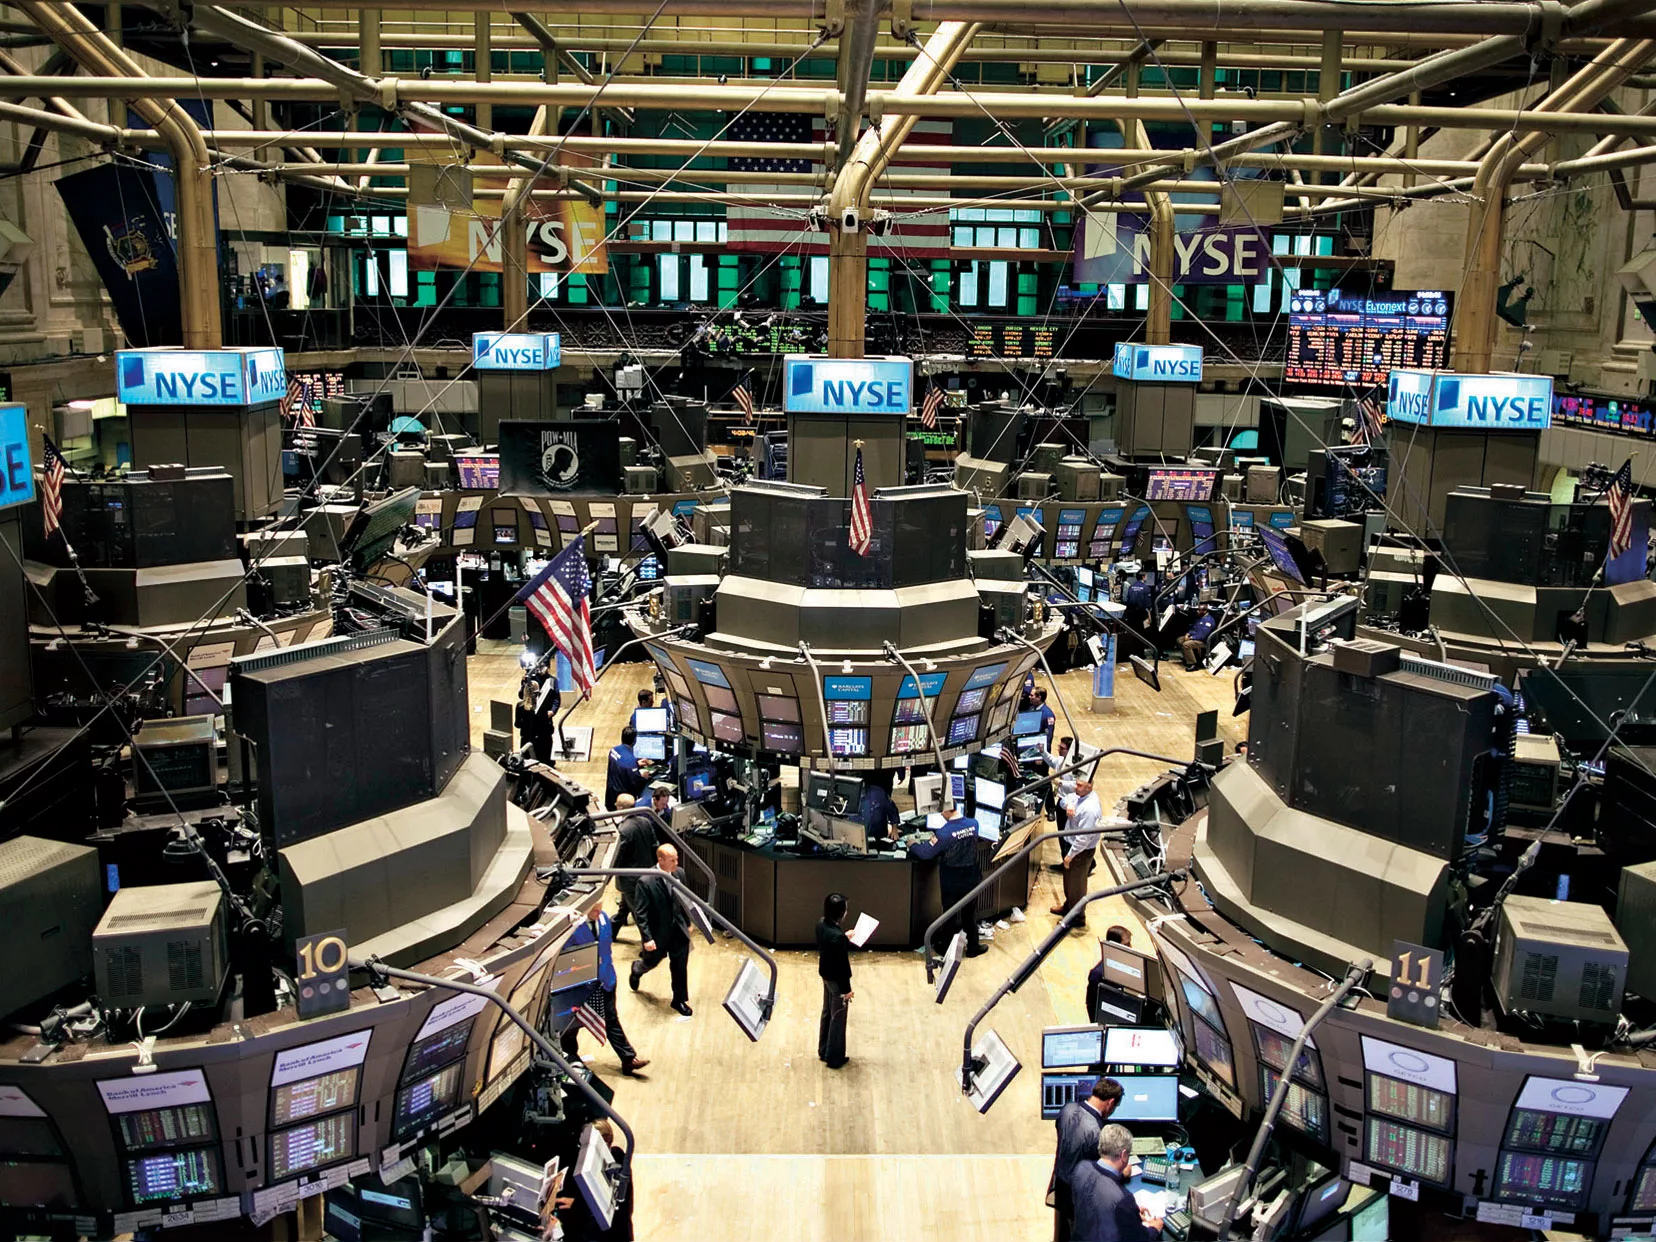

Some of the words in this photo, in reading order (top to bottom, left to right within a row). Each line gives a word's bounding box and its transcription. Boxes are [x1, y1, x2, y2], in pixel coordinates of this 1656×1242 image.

[468, 220, 598, 264] NSE
[1339, 299, 1362, 310] NYSE
[1365, 299, 1406, 312] Euronext
[494, 348, 543, 364] NYSE
[1153, 359, 1200, 376] NYSE
[155, 371, 238, 399] NYSE
[260, 369, 285, 395] NYSE
[823, 379, 903, 407] NYSE
[1399, 391, 1428, 418] NYSE
[1466, 395, 1545, 423] NYSE
[0, 442, 28, 494] E
[322, 572, 329, 589] 7
[299, 936, 347, 980] 10
[1396, 950, 1432, 990] 11
[278, 1061, 306, 1073] Merrill
[307, 1055, 332, 1065] Lynch
[280, 1059, 301, 1068] Bank
[310, 1048, 343, 1060] America
[106, 1089, 129, 1097] Bank
[140, 1084, 177, 1092] America
